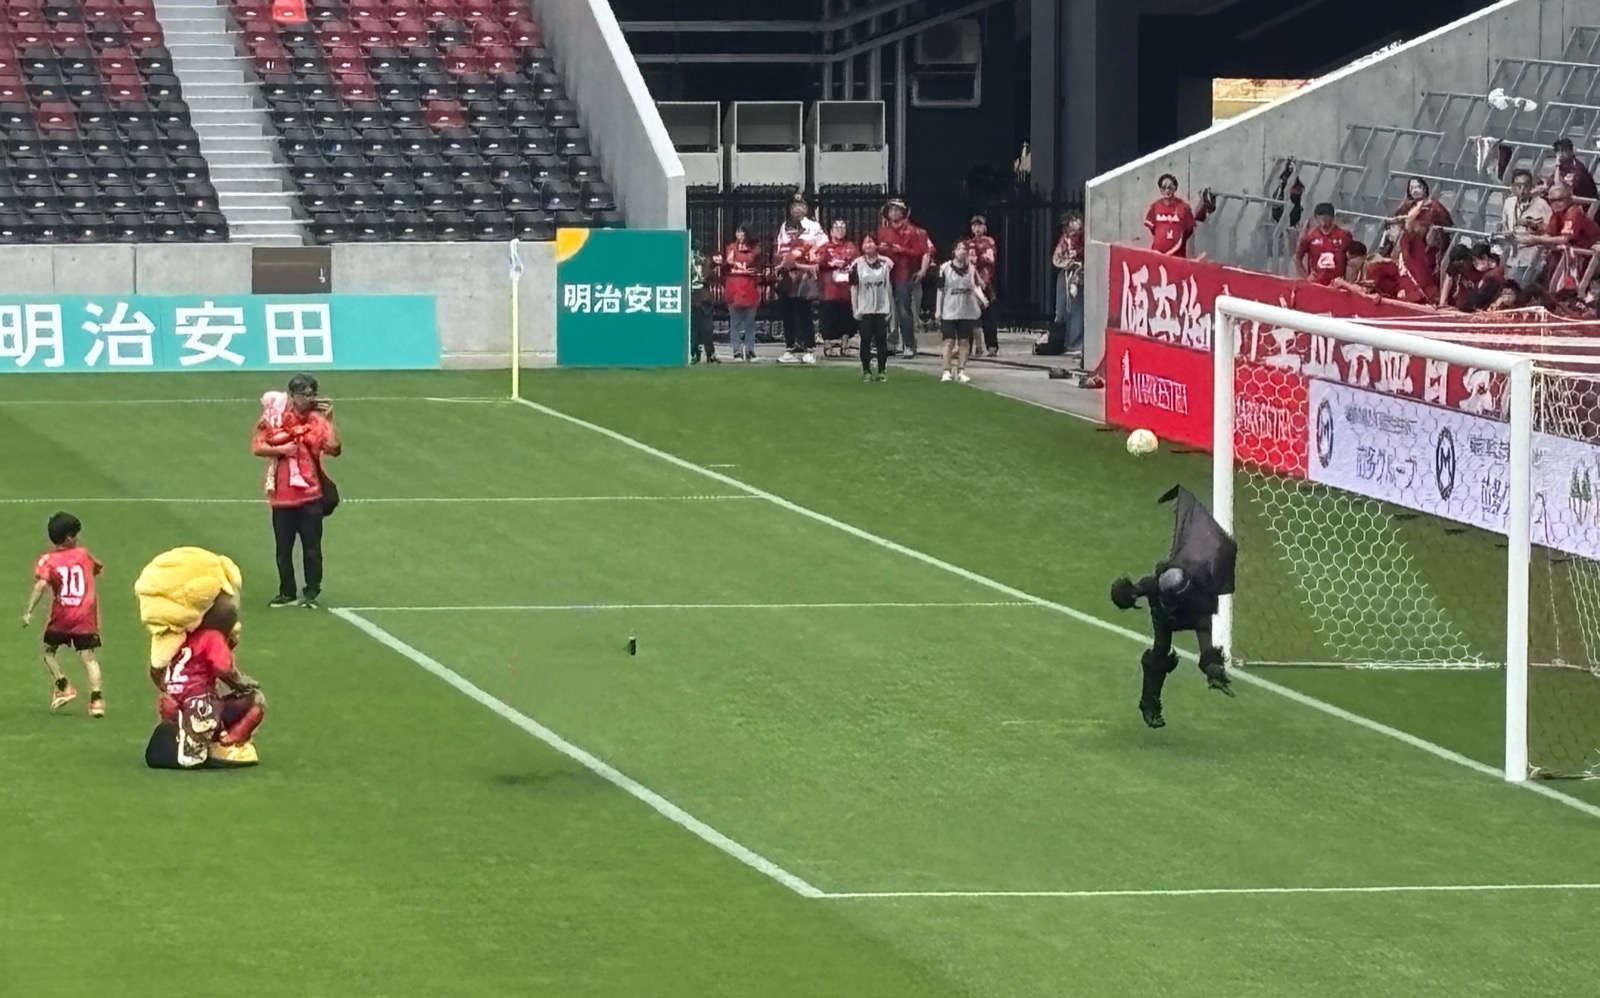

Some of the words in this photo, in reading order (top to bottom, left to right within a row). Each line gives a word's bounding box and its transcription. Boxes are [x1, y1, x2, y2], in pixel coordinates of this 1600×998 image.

[564, 284, 681, 313] 明治安田
[0, 301, 333, 367] 明治安田
[57, 564, 85, 597] 10
